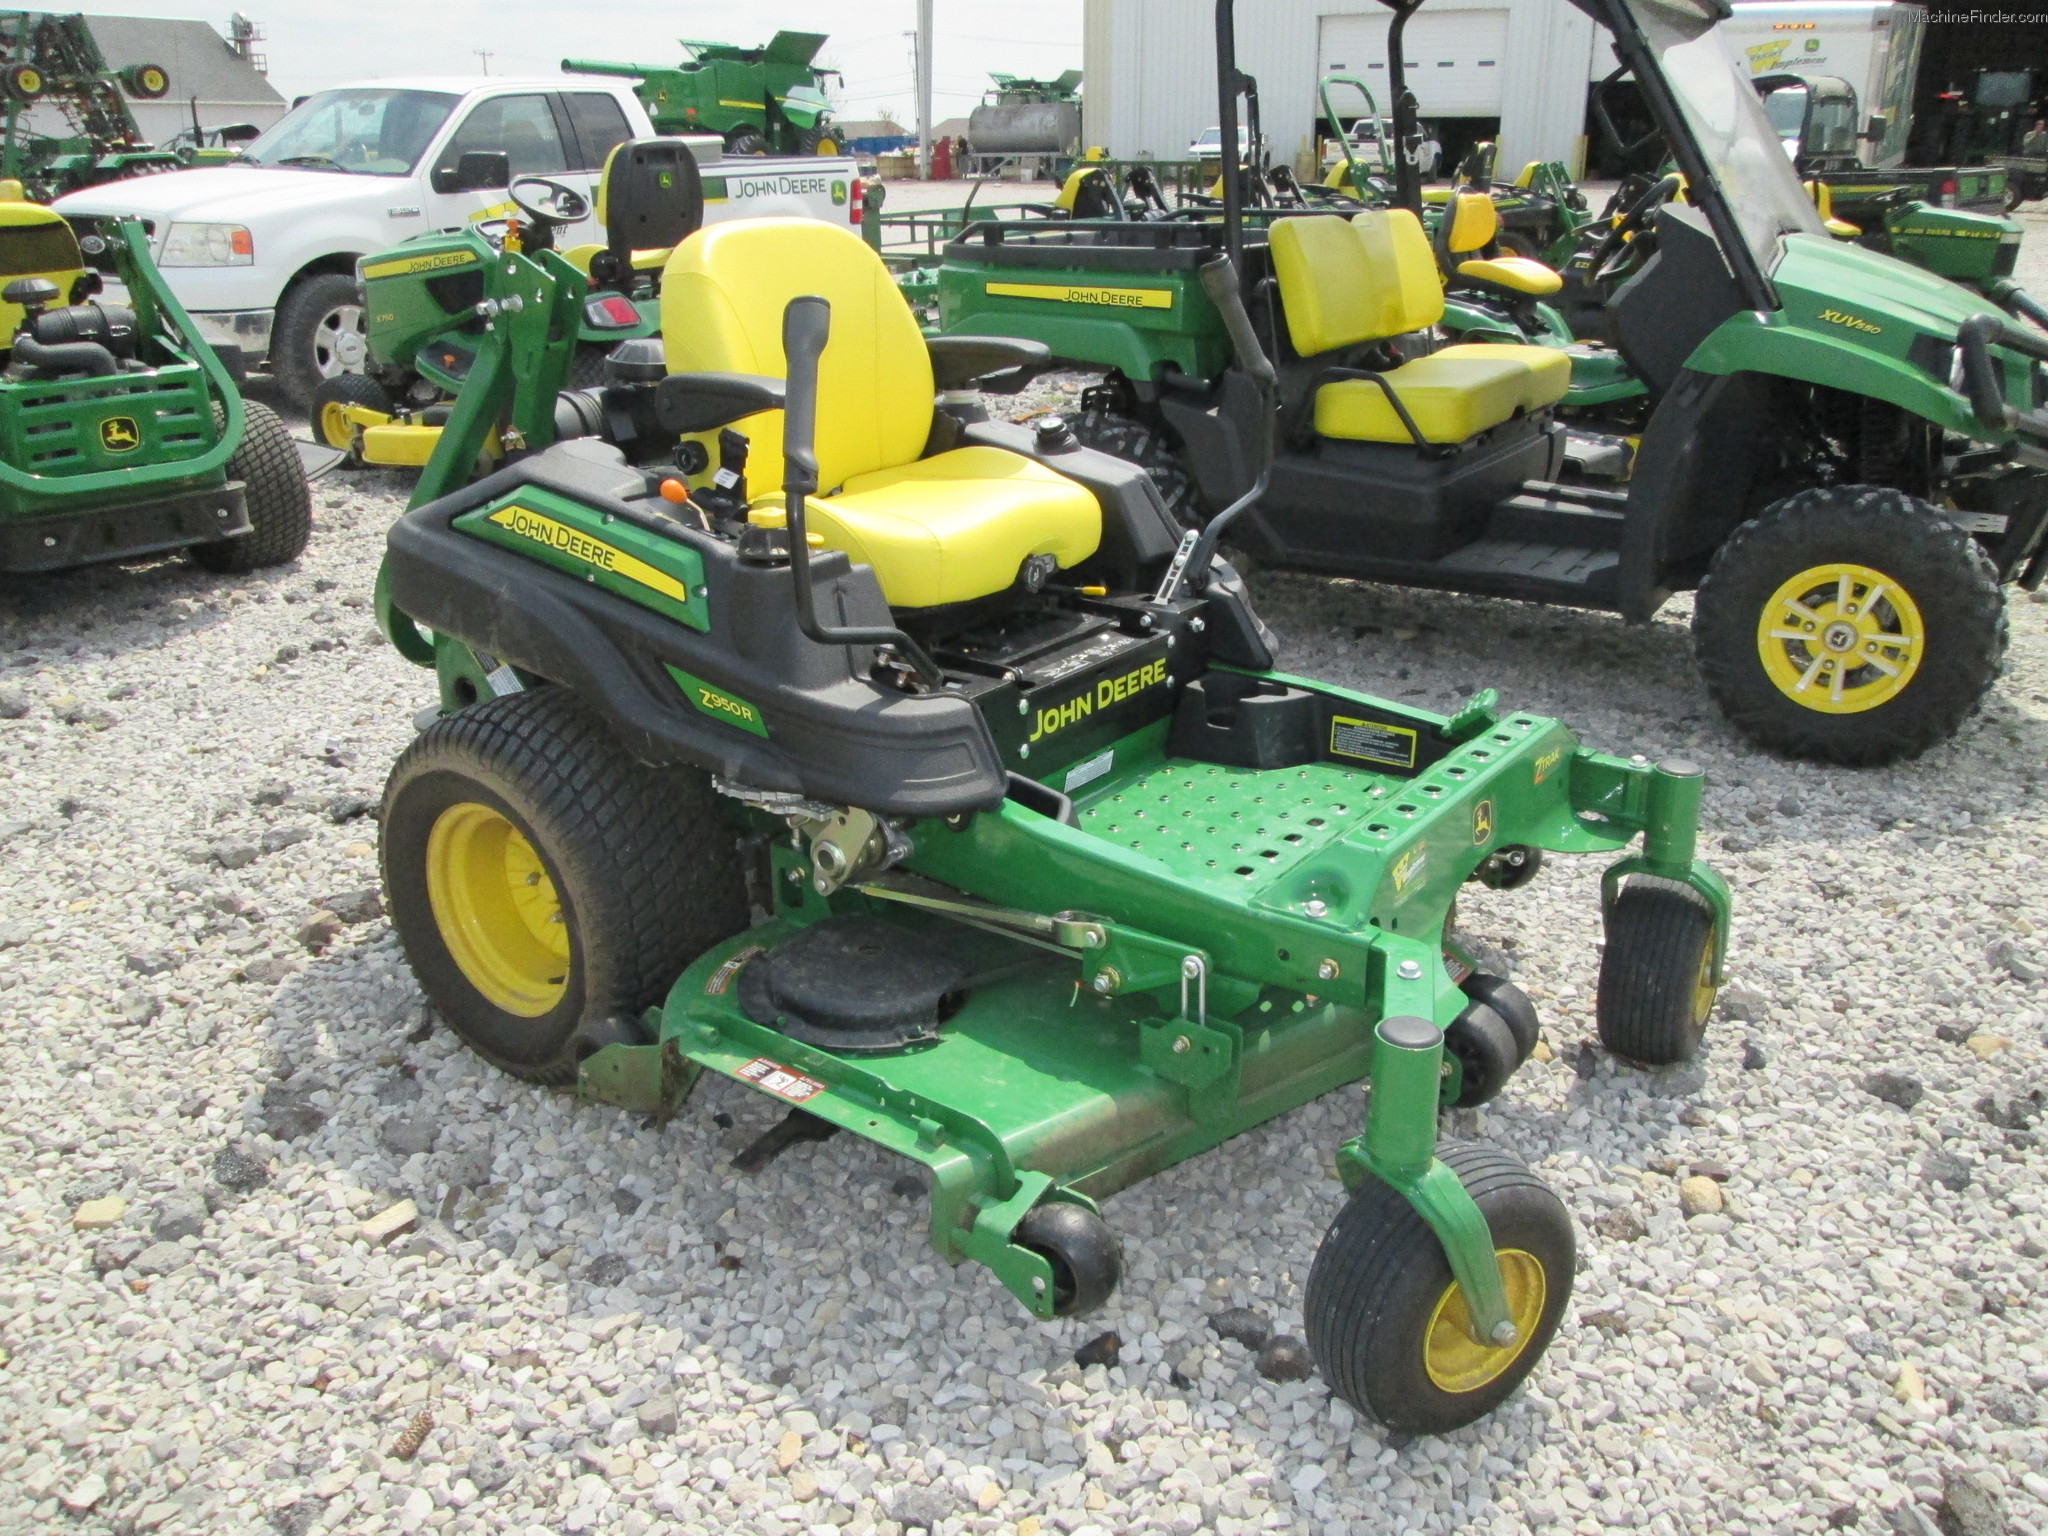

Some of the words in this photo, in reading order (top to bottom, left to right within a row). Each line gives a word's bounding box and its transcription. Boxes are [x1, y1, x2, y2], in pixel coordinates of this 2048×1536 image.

[735, 179, 777, 198] JOHN
[779, 177, 827, 195] DEERE
[408, 259, 432, 274] JOHN
[433, 254, 466, 268] DEERE
[1064, 289, 1098, 303] JOHN
[1101, 291, 1143, 306] DEERE
[505, 510, 553, 543] JOHN
[555, 526, 616, 569] DEERE
[698, 687, 754, 722] Z950R
[1029, 692, 1092, 743] JOHN
[1097, 657, 1167, 711] DEERE
